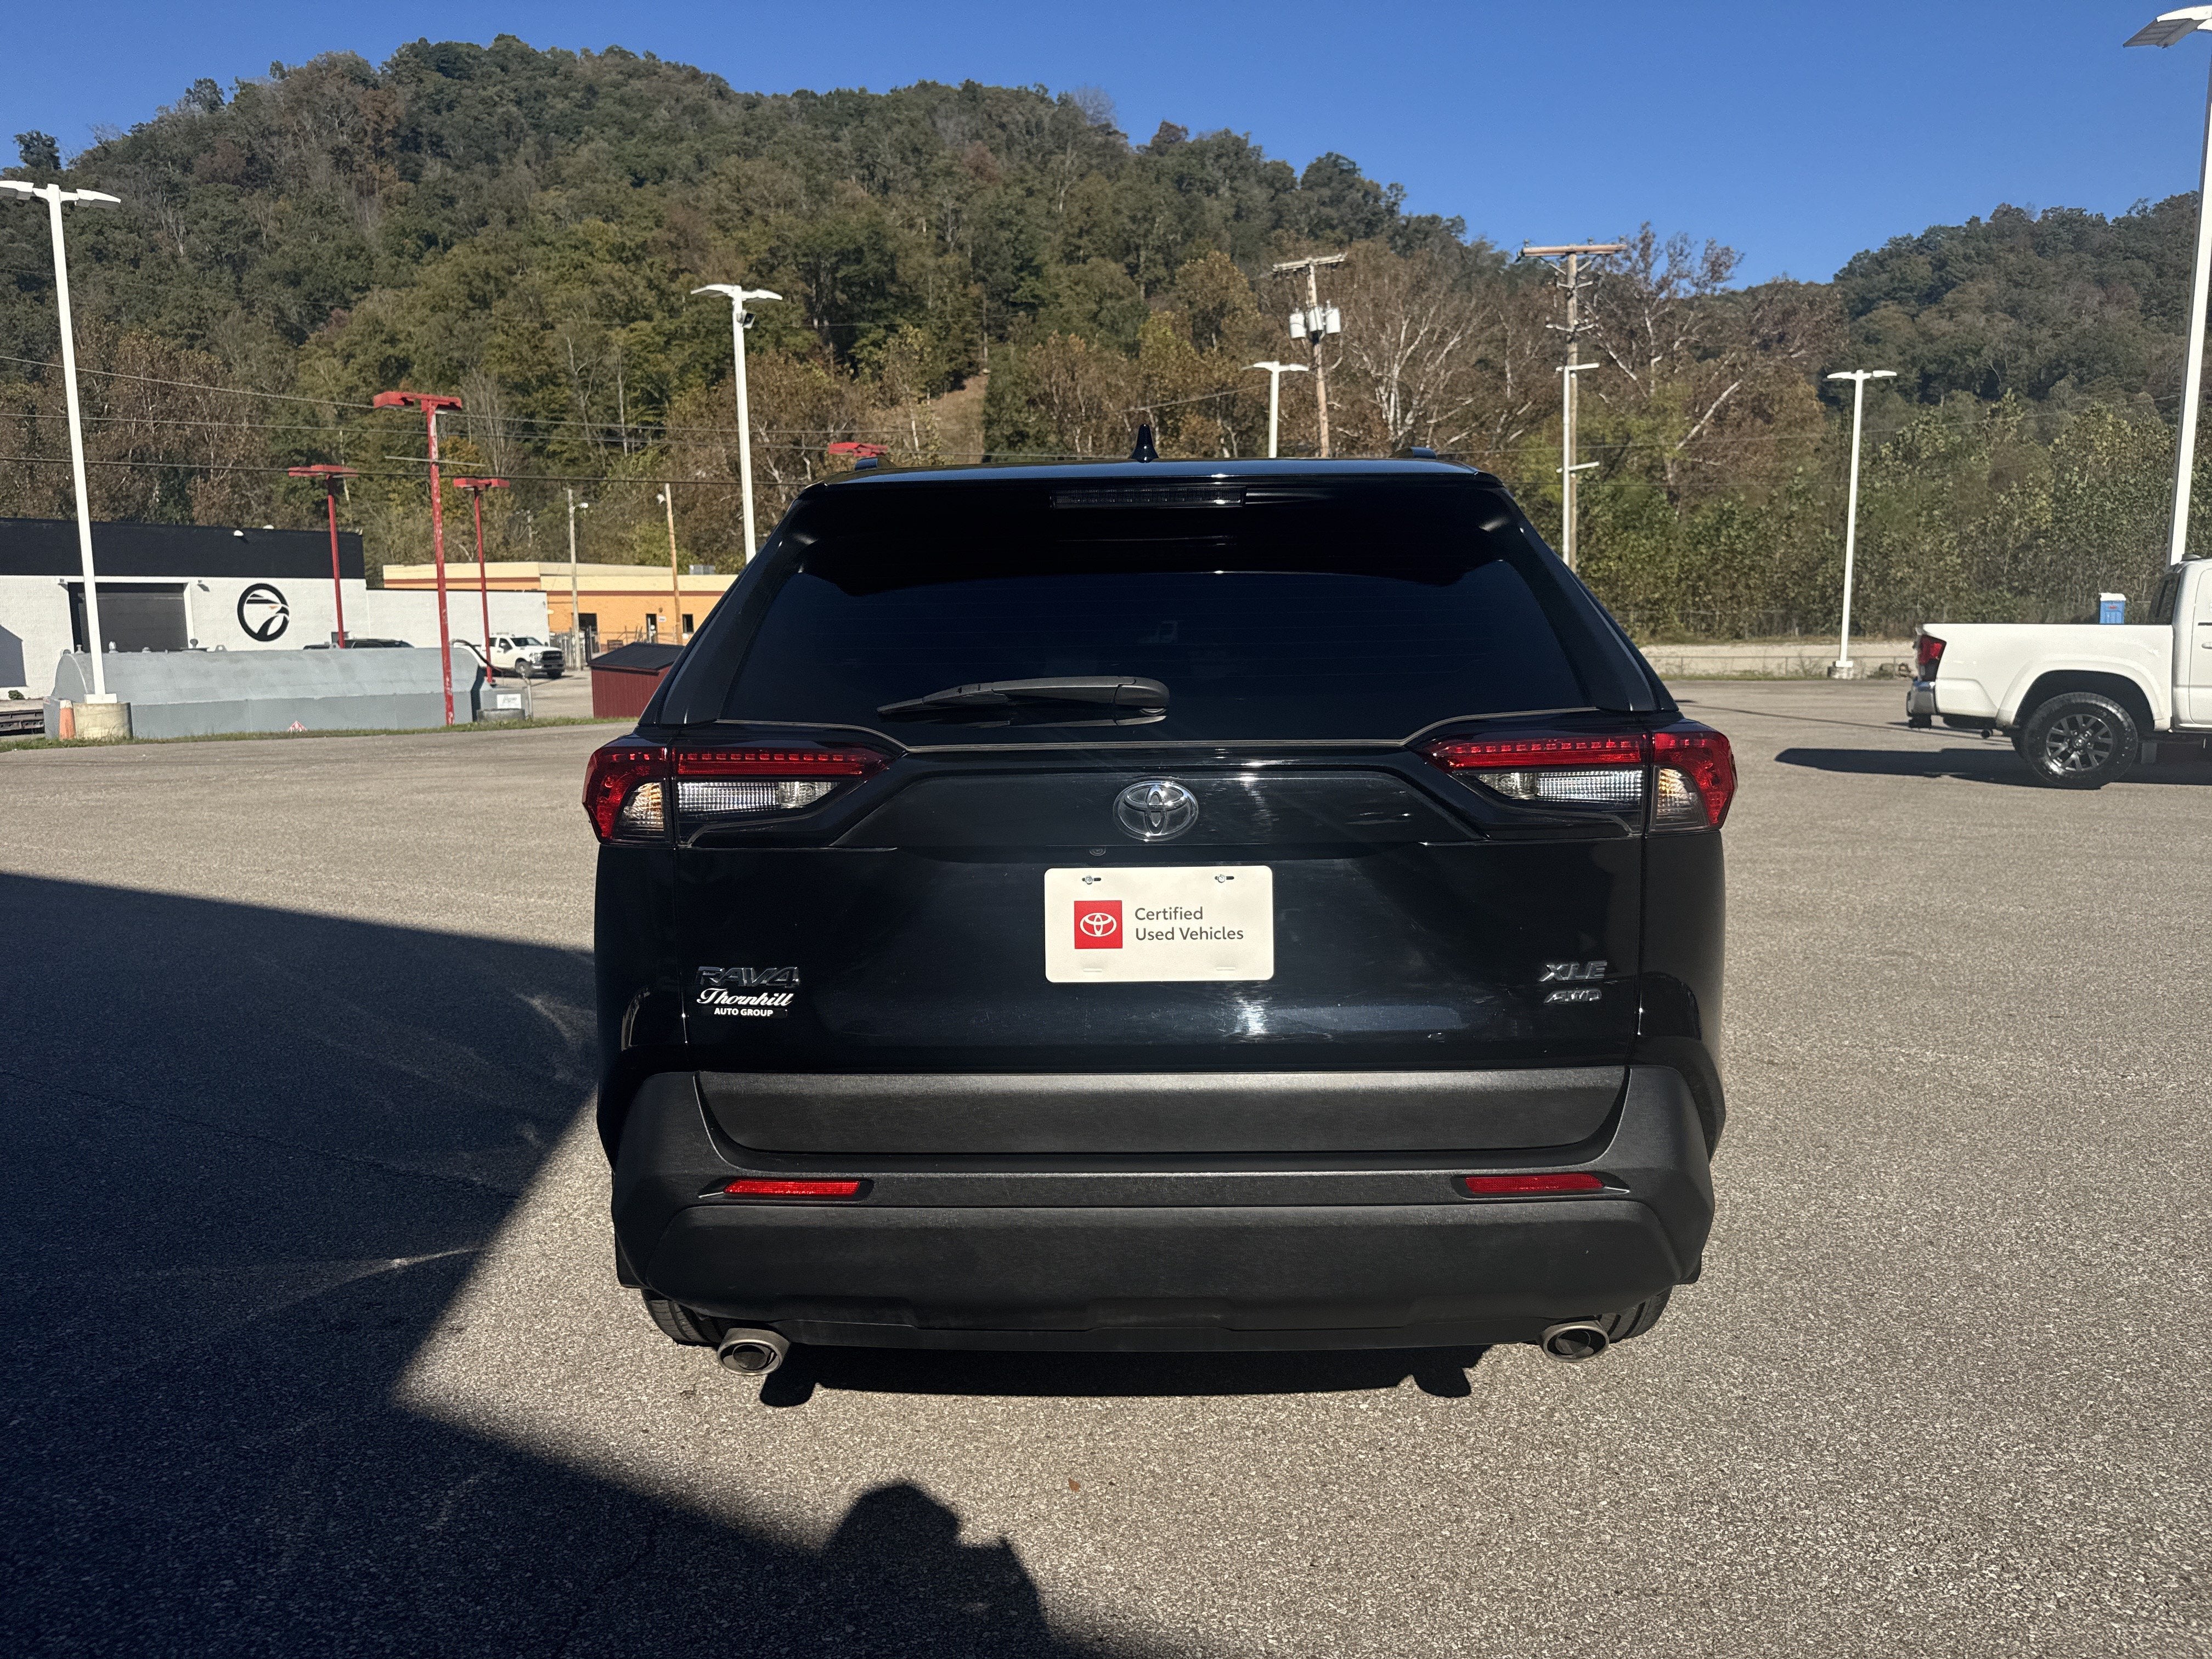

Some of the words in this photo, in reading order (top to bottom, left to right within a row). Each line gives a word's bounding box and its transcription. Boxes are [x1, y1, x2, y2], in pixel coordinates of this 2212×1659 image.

[1135, 906, 1203, 921] Certified
[1136, 927, 1175, 941] Used
[1179, 926, 1244, 940] Vehicles
[697, 966, 800, 988] RAV4
[1538, 960, 1607, 982] XLE
[696, 988, 794, 1006] Thornhill
[714, 1007, 739, 1015] AUTO
[741, 1008, 774, 1017] GROUP
